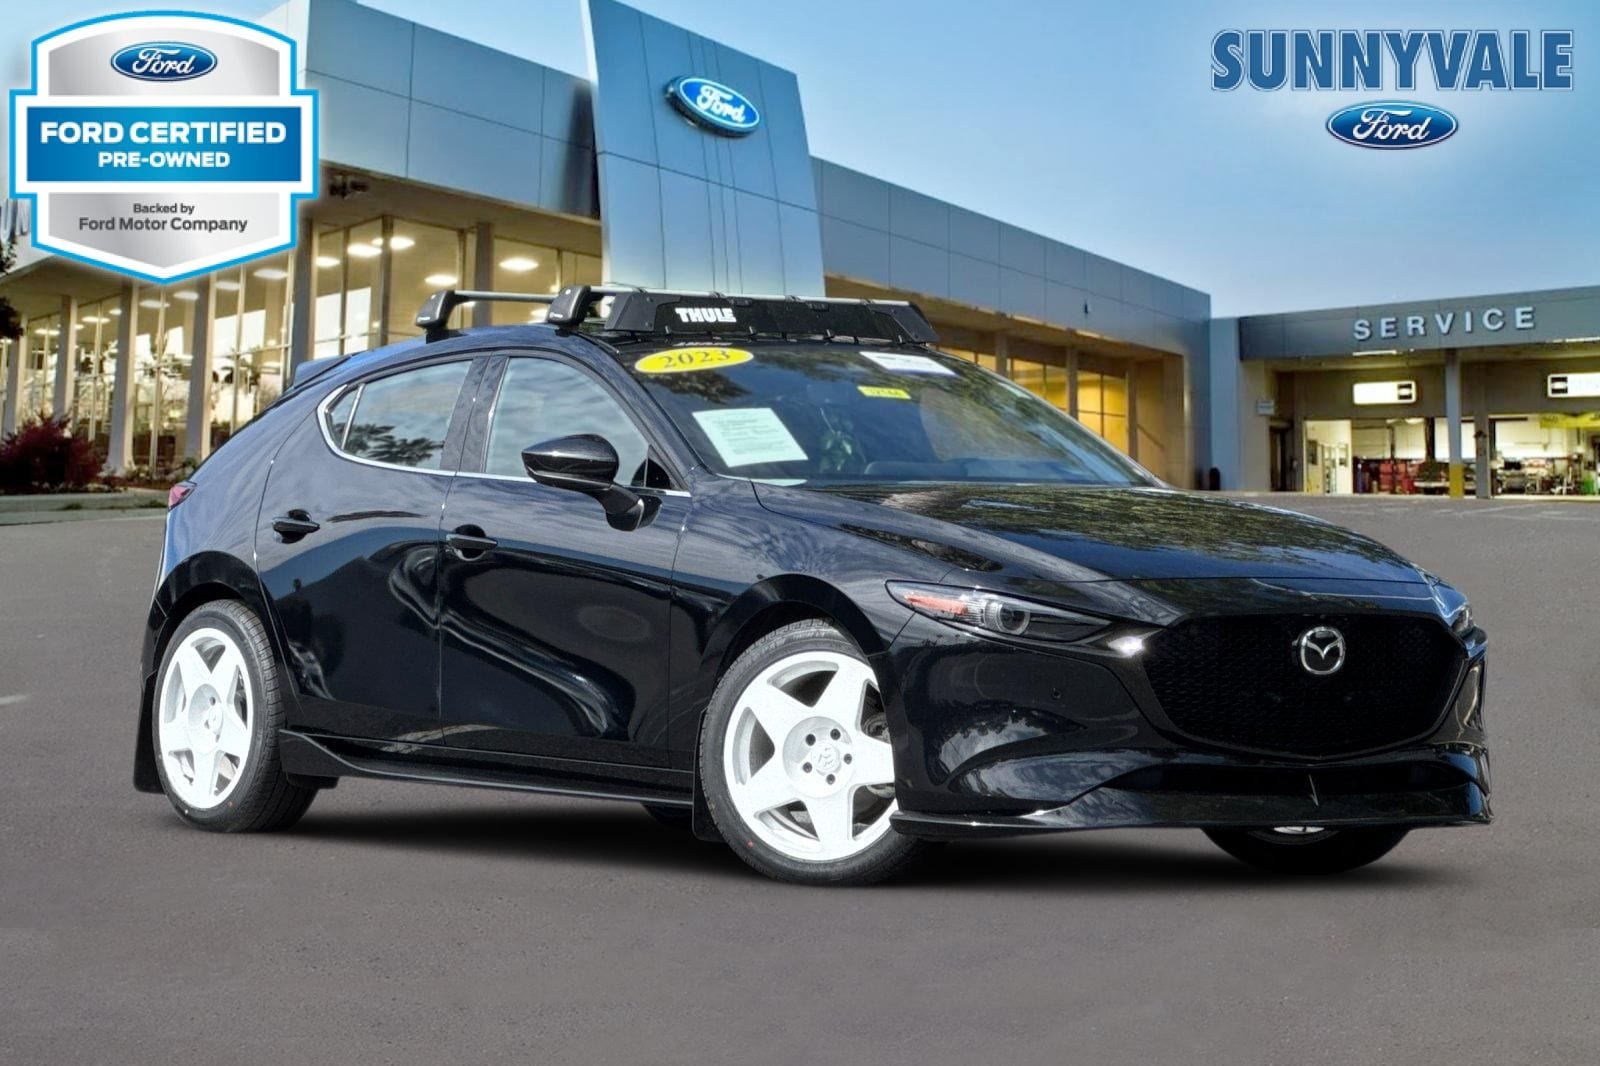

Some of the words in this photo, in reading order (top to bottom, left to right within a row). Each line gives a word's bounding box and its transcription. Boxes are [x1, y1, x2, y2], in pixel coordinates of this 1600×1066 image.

[696, 84, 746, 123] Ford
[675, 307, 737, 323] THULE
[1353, 306, 1535, 341] SERVICE
[659, 350, 731, 369] 2023
